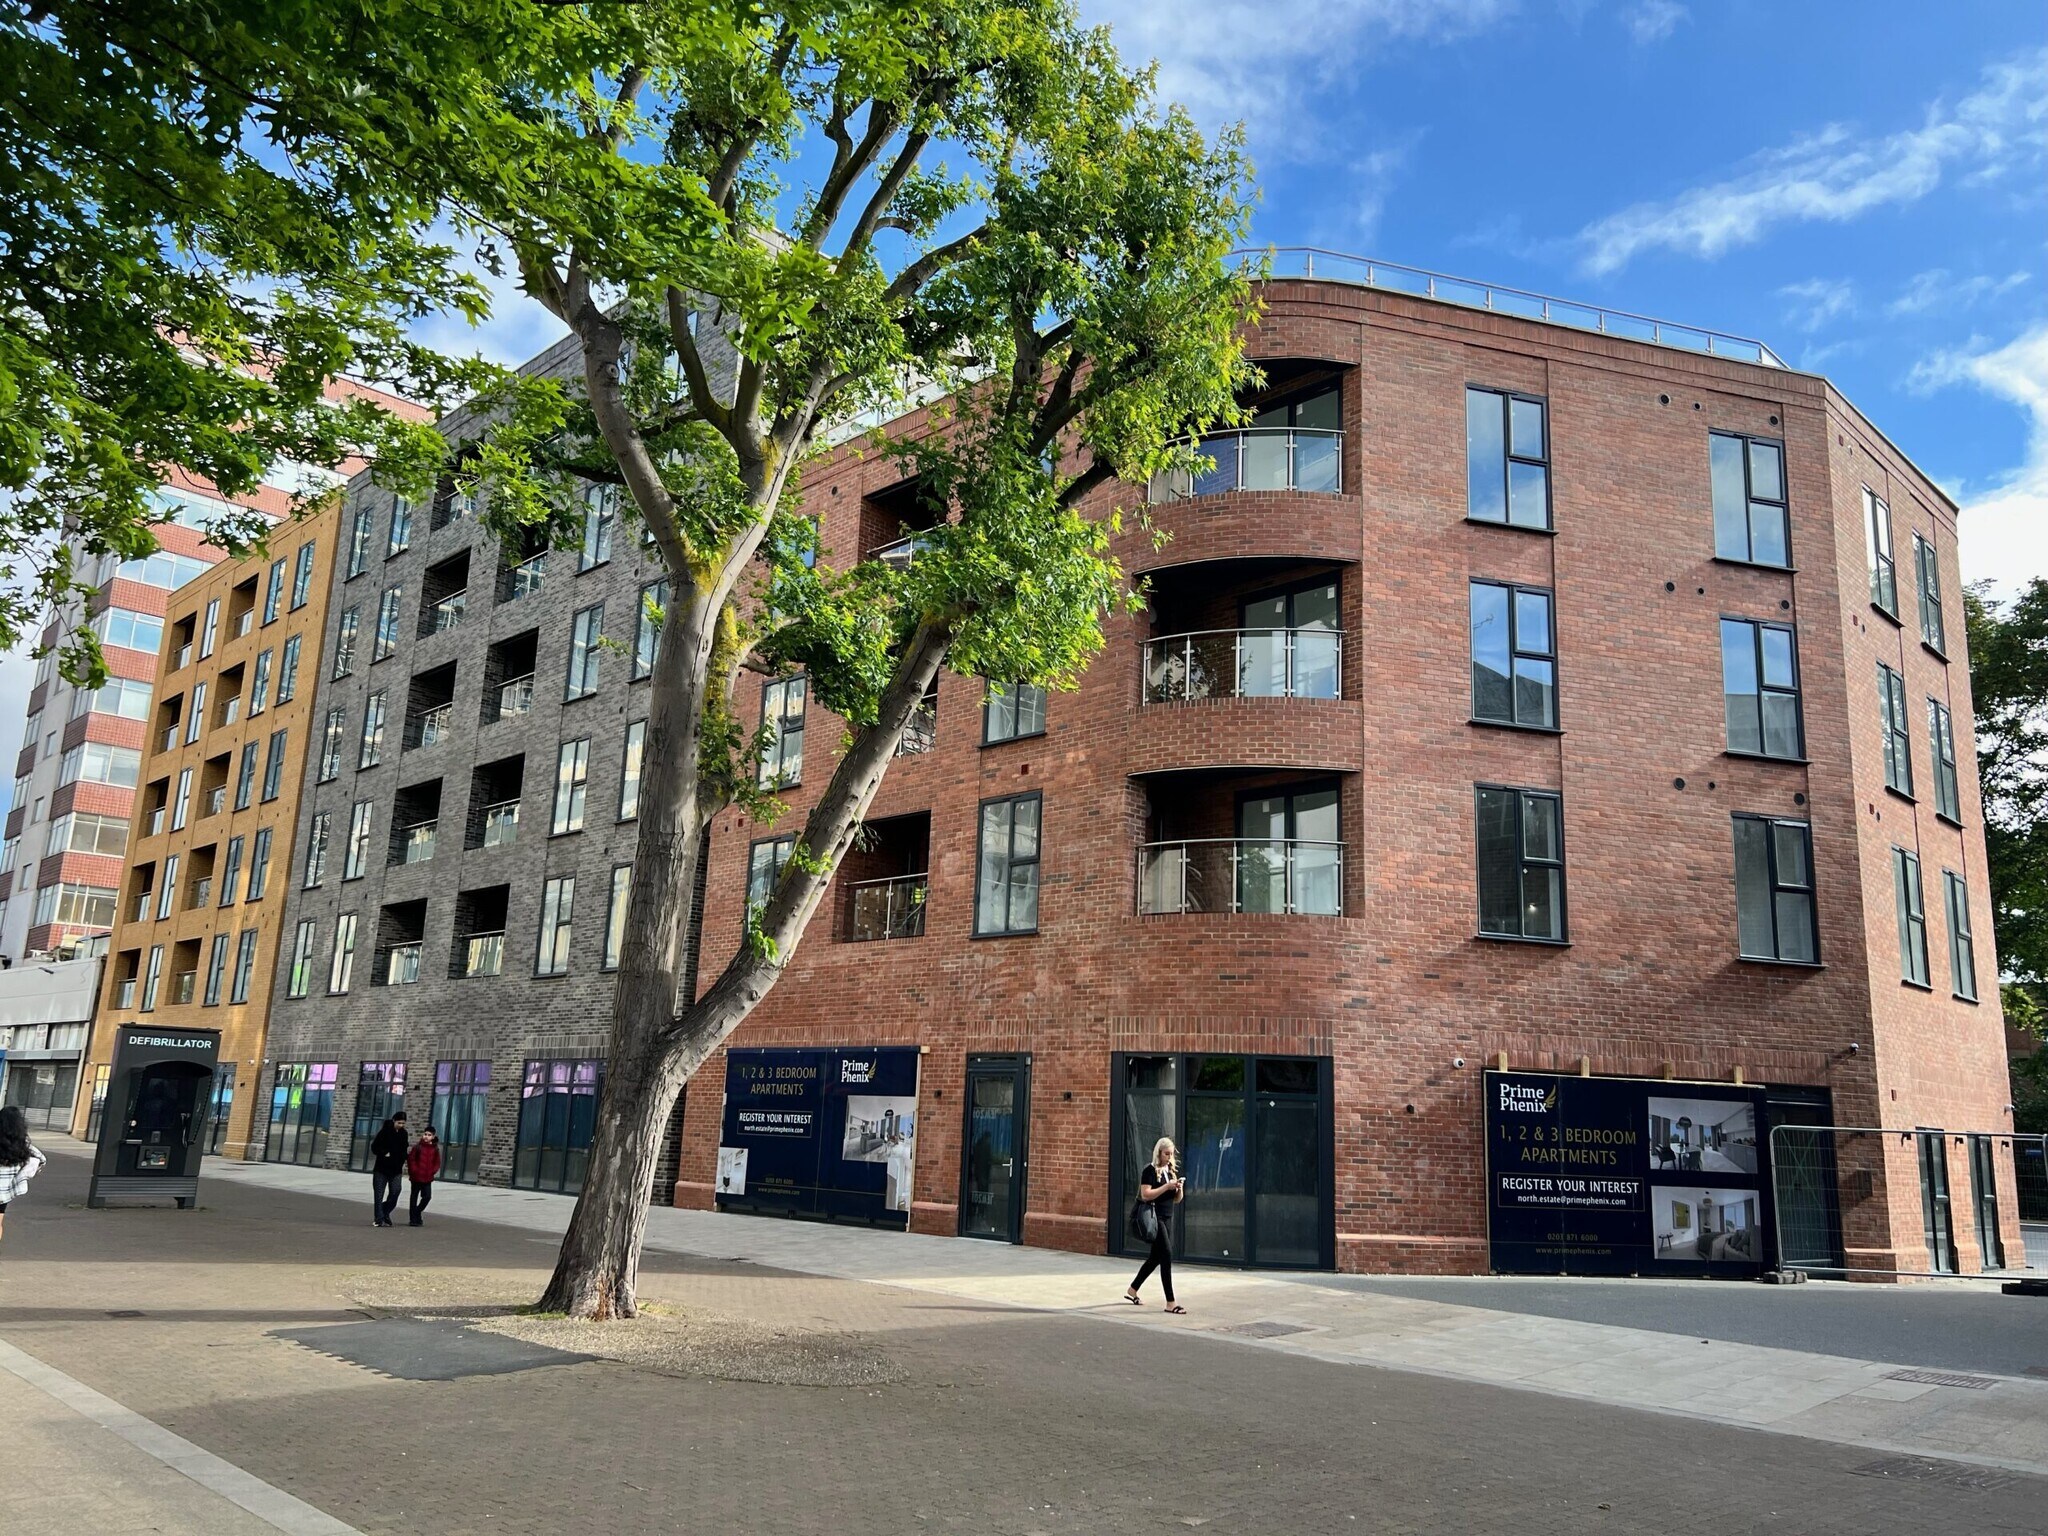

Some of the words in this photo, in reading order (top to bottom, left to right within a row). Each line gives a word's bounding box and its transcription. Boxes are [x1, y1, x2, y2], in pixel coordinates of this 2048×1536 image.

[129, 1036, 212, 1048] DEFIBRILLATOR
[842, 1059, 869, 1072] Prime
[751, 1067, 757, 1078] 2
[758, 1067, 765, 1079] &
[768, 1066, 773, 1079] 3
[775, 1067, 817, 1079] BEDROOM
[840, 1070, 870, 1083] Phenix
[750, 1083, 804, 1096] APARTMENTS
[1500, 1083, 1545, 1099] Prime
[1500, 1097, 1547, 1113] Phenix
[739, 1112, 766, 1123] REGISTER
[766, 1113, 783, 1123] YOUR
[783, 1114, 812, 1124] INTEREST
[1500, 1124, 1512, 1142] 1,
[1519, 1125, 1527, 1140] 2
[1534, 1126, 1544, 1141] &
[1551, 1127, 1559, 1142] 3
[1566, 1128, 1637, 1145] BEDROOM
[1521, 1147, 1617, 1165] APARTMENTS
[1502, 1177, 1553, 1191] REGISTER
[1556, 1179, 1586, 1192] YOUR
[1589, 1180, 1639, 1194] INTEREST
[1517, 1194, 1626, 1206] north.estate@primephenix.com
